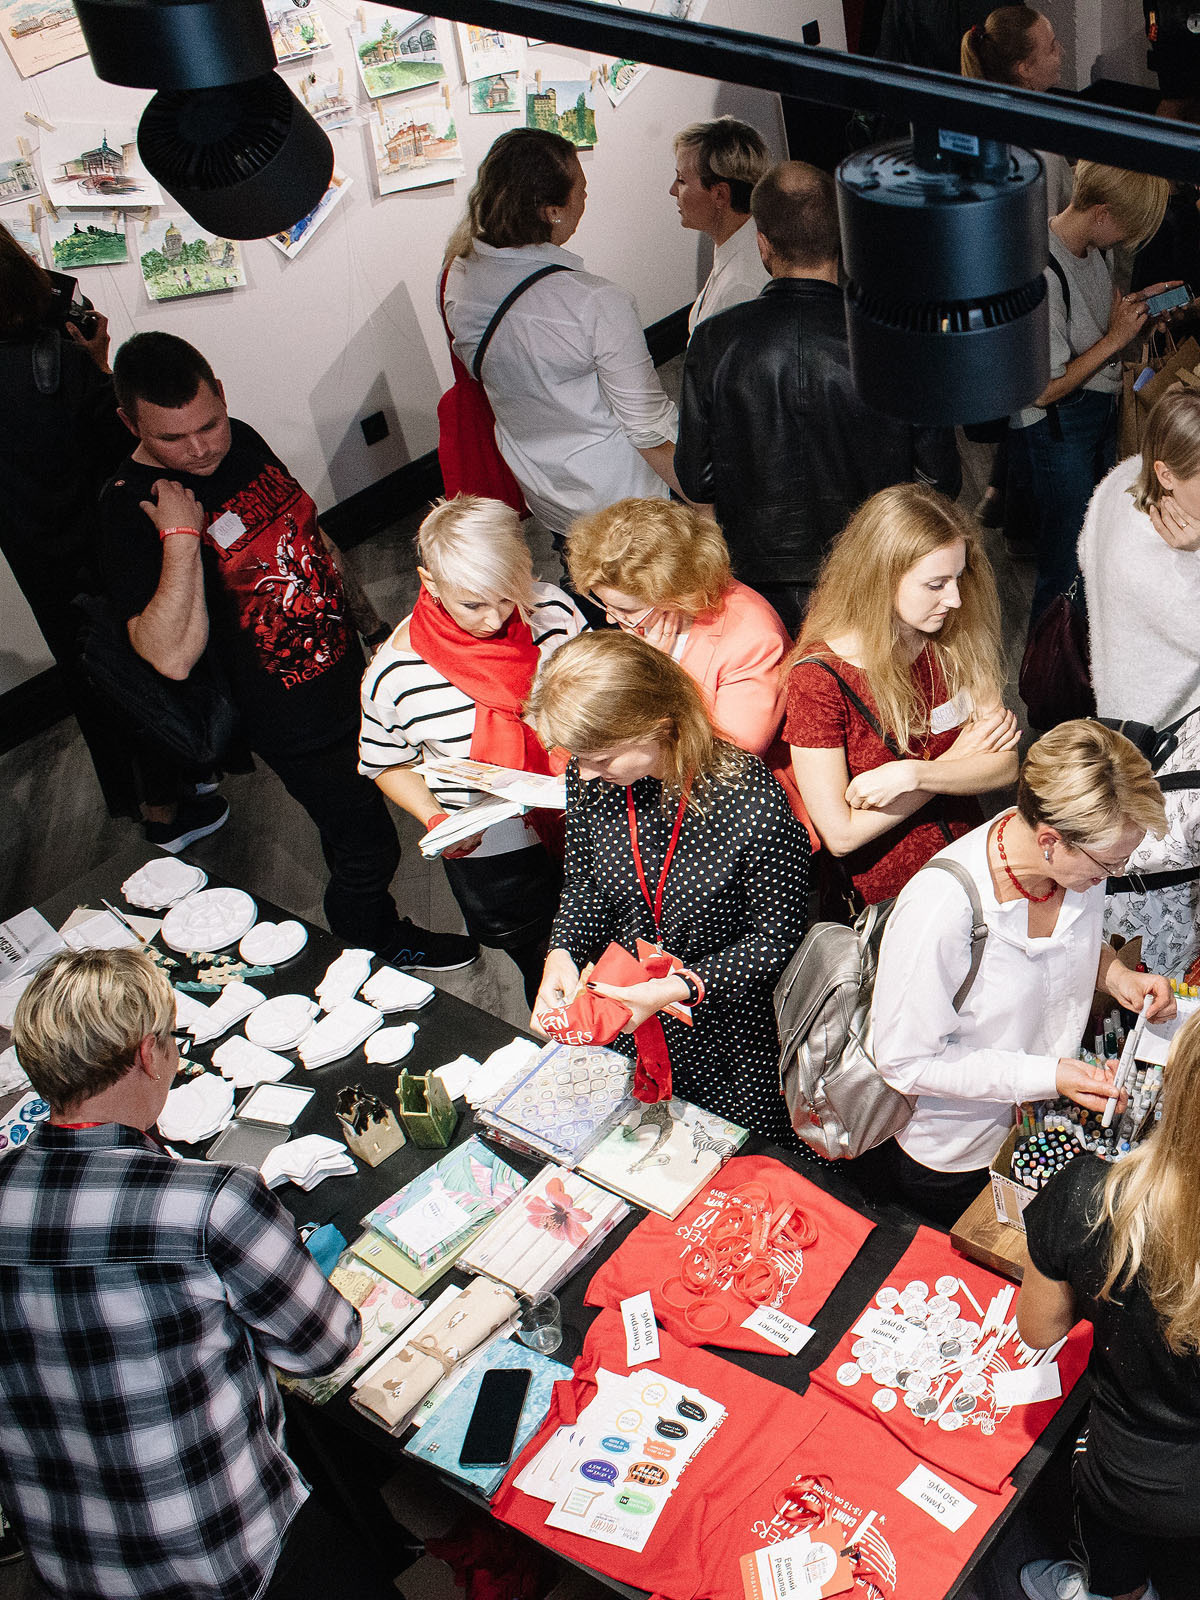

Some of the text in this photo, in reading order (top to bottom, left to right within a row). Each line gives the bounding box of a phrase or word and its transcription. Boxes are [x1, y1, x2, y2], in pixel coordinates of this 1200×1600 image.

[630, 1312, 640, 1351] Стикеры
[641, 1309, 653, 1345] 100 руб.
[757, 1321, 790, 1344] Браслет
[766, 1312, 798, 1334] 150 руб.
[879, 1318, 908, 1334] 50 руб.
[871, 1327, 900, 1344] Значок
[920, 1492, 947, 1515] Сумка
[926, 1479, 960, 1508] 350 руб.
[843, 1500, 864, 1517] 13-15
[774, 1558, 786, 1597] Речкалов
[785, 1558, 796, 1591] Евгений
